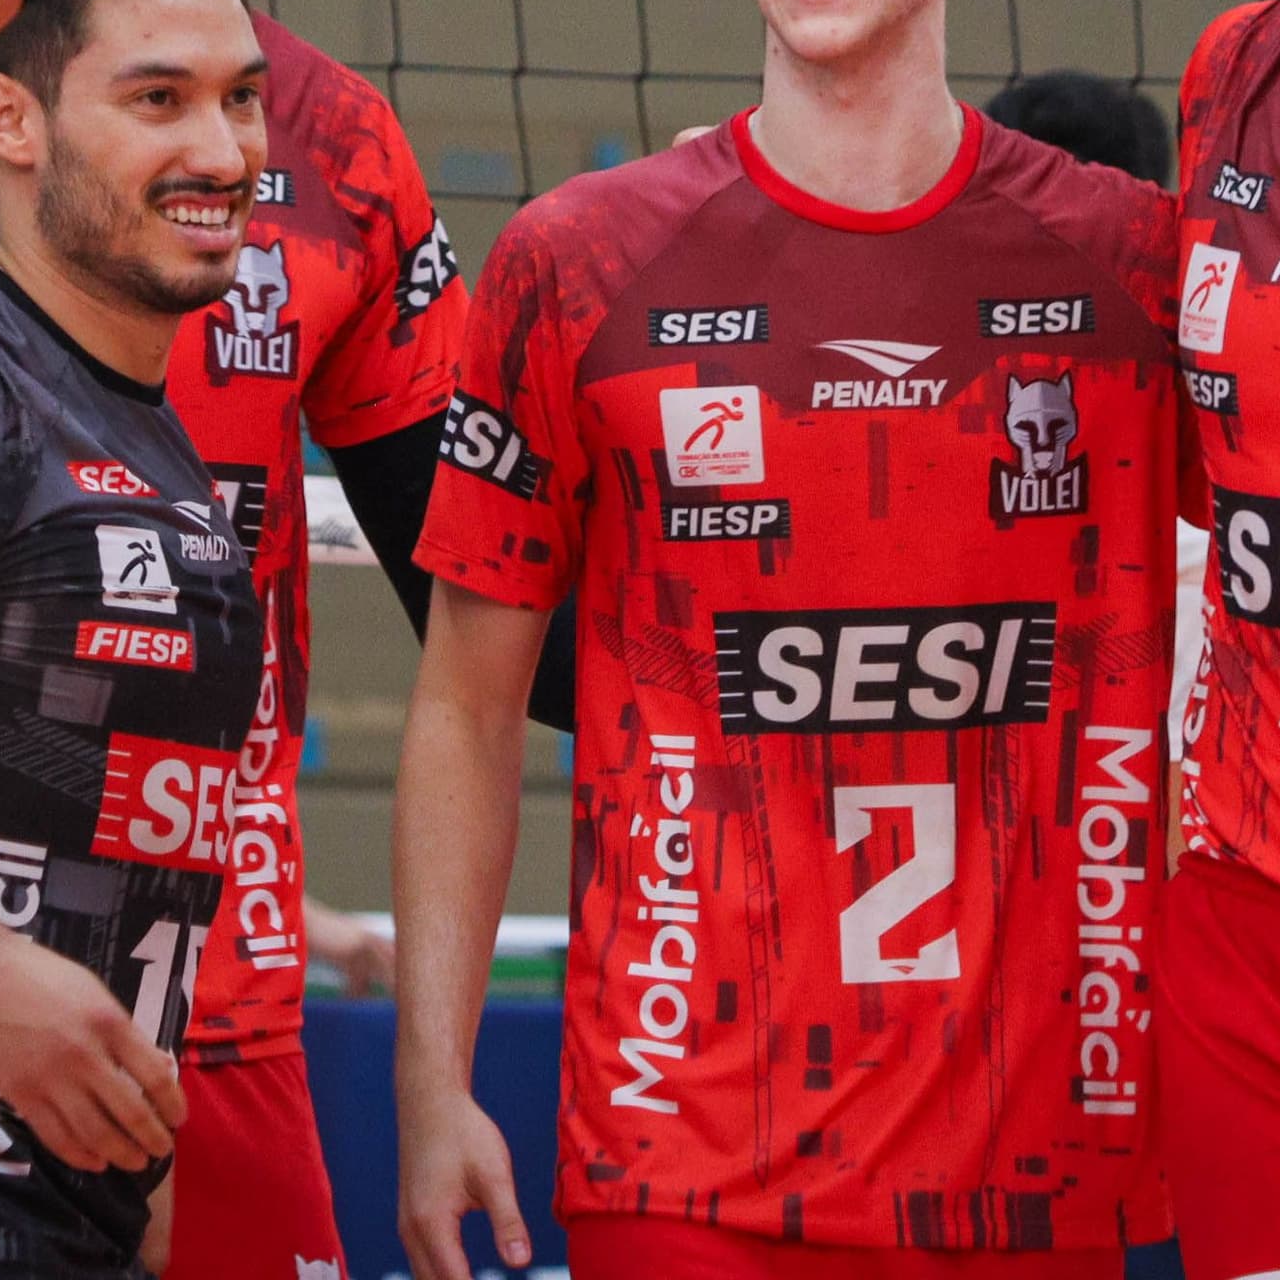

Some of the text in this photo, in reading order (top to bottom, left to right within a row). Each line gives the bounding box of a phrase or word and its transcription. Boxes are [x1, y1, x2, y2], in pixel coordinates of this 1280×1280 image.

[255, 172, 286, 202] SI
[658, 310, 757, 343] SESI
[989, 300, 1083, 334] SESI
[812, 379, 948, 409] PENALTY
[1184, 368, 1230, 409] ESP
[1001, 466, 1080, 513] VÔLEI
[670, 504, 779, 538] FIESP
[88, 627, 188, 664] FIESP
[753, 619, 1025, 723] SESI
[128, 758, 237, 864] SES
[834, 783, 961, 984] 2
[610, 734, 699, 1115] Mobifácil
[1078, 725, 1152, 1116] Mobifácil
[129, 920, 209, 1051] 1
